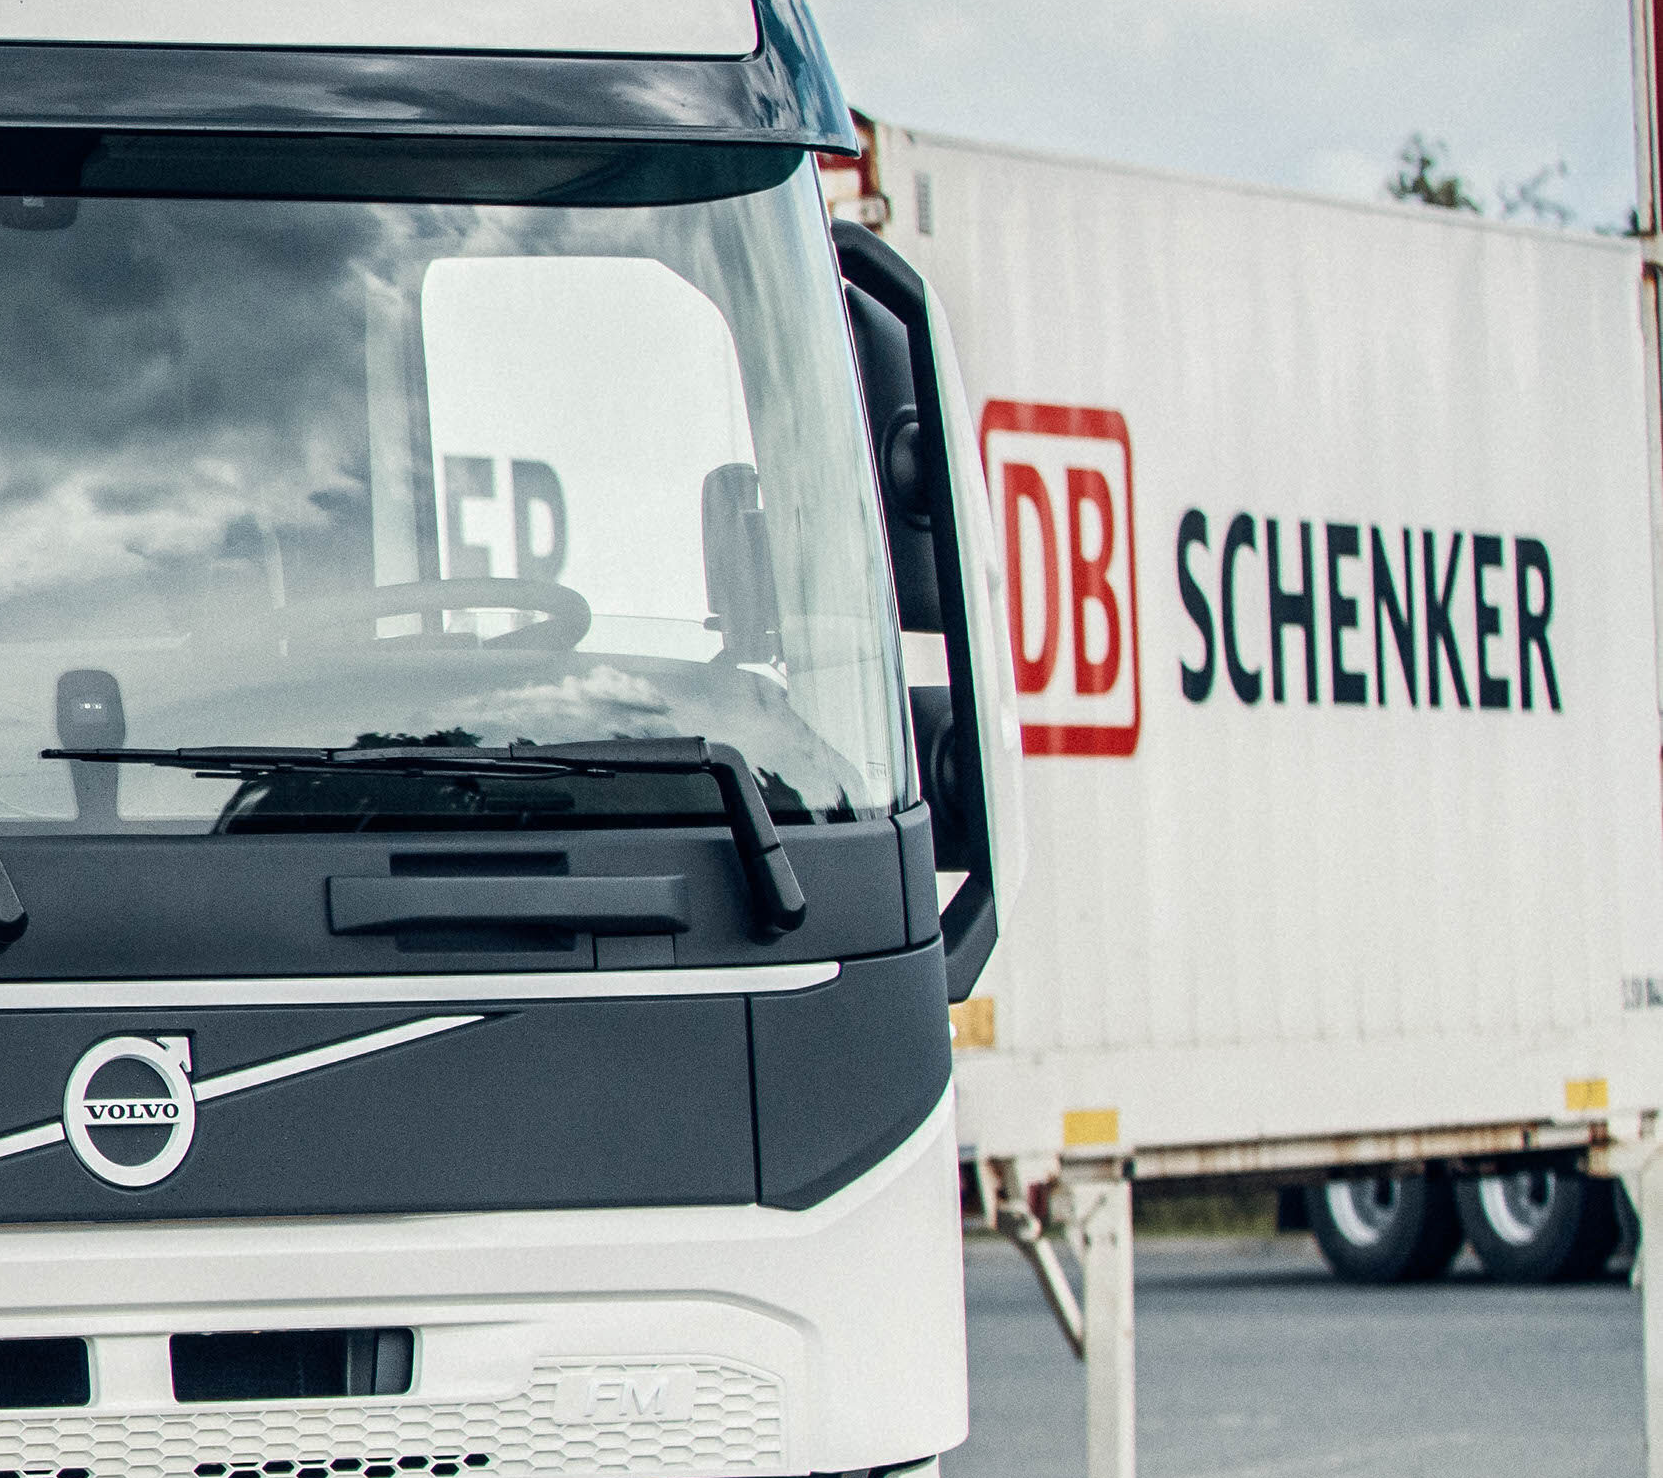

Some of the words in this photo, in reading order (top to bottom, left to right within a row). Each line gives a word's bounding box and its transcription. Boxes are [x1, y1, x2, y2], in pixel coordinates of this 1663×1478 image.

[999, 459, 1123, 699] DB
[1175, 507, 1562, 713] SCHENKER
[83, 1102, 179, 1120] VOLVO
[582, 1376, 669, 1418] FM
